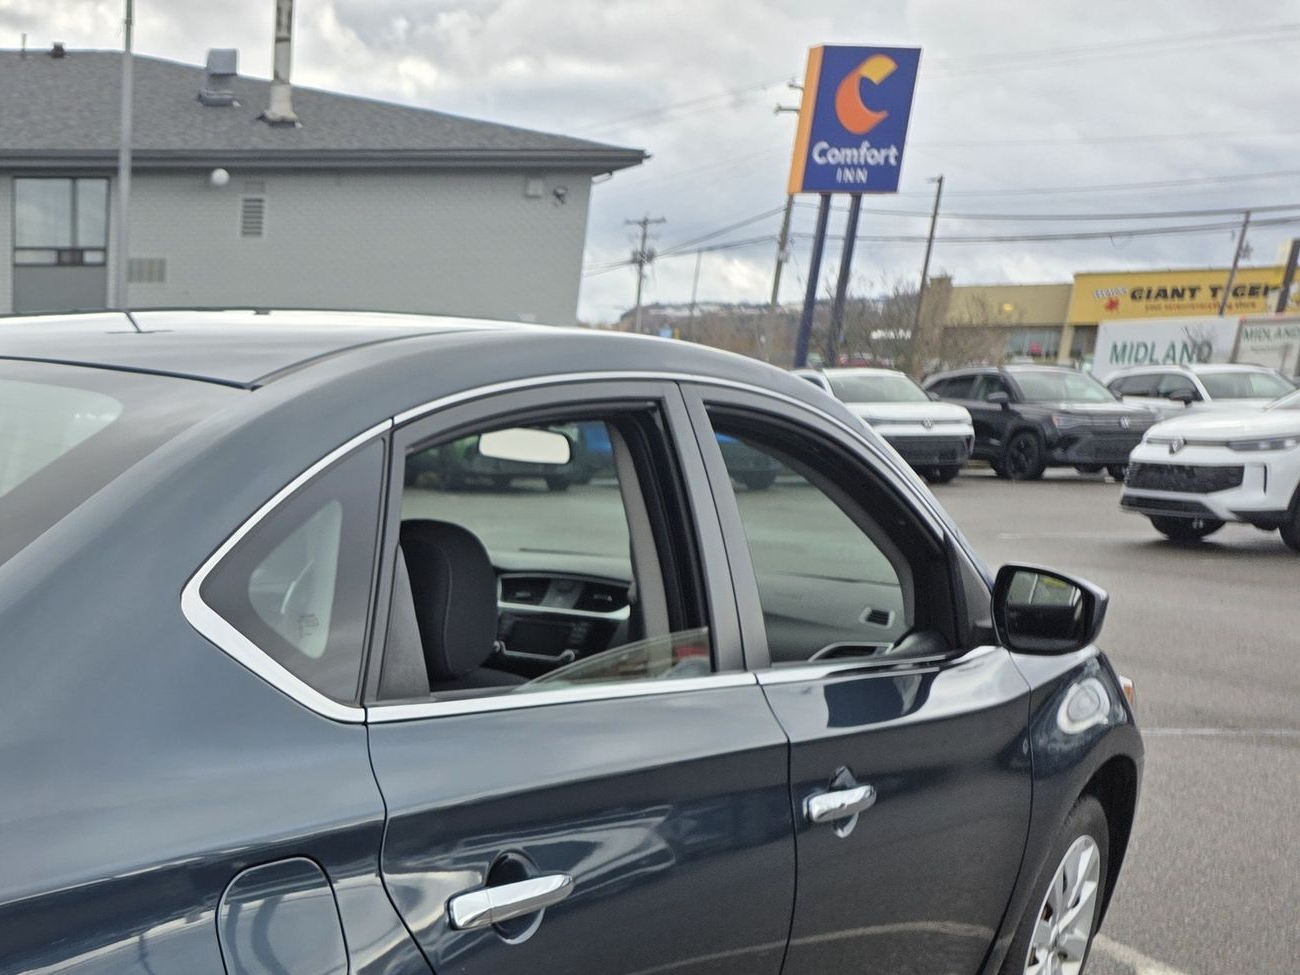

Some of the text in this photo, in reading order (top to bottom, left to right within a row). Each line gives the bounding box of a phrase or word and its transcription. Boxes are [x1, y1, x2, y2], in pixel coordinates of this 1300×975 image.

[812, 141, 898, 165] Comfort
[836, 167, 868, 183] INN
[1130, 285, 1201, 301] GIANT
[1209, 283, 1280, 298] TGE
[1109, 341, 1213, 366] MIDLAND
